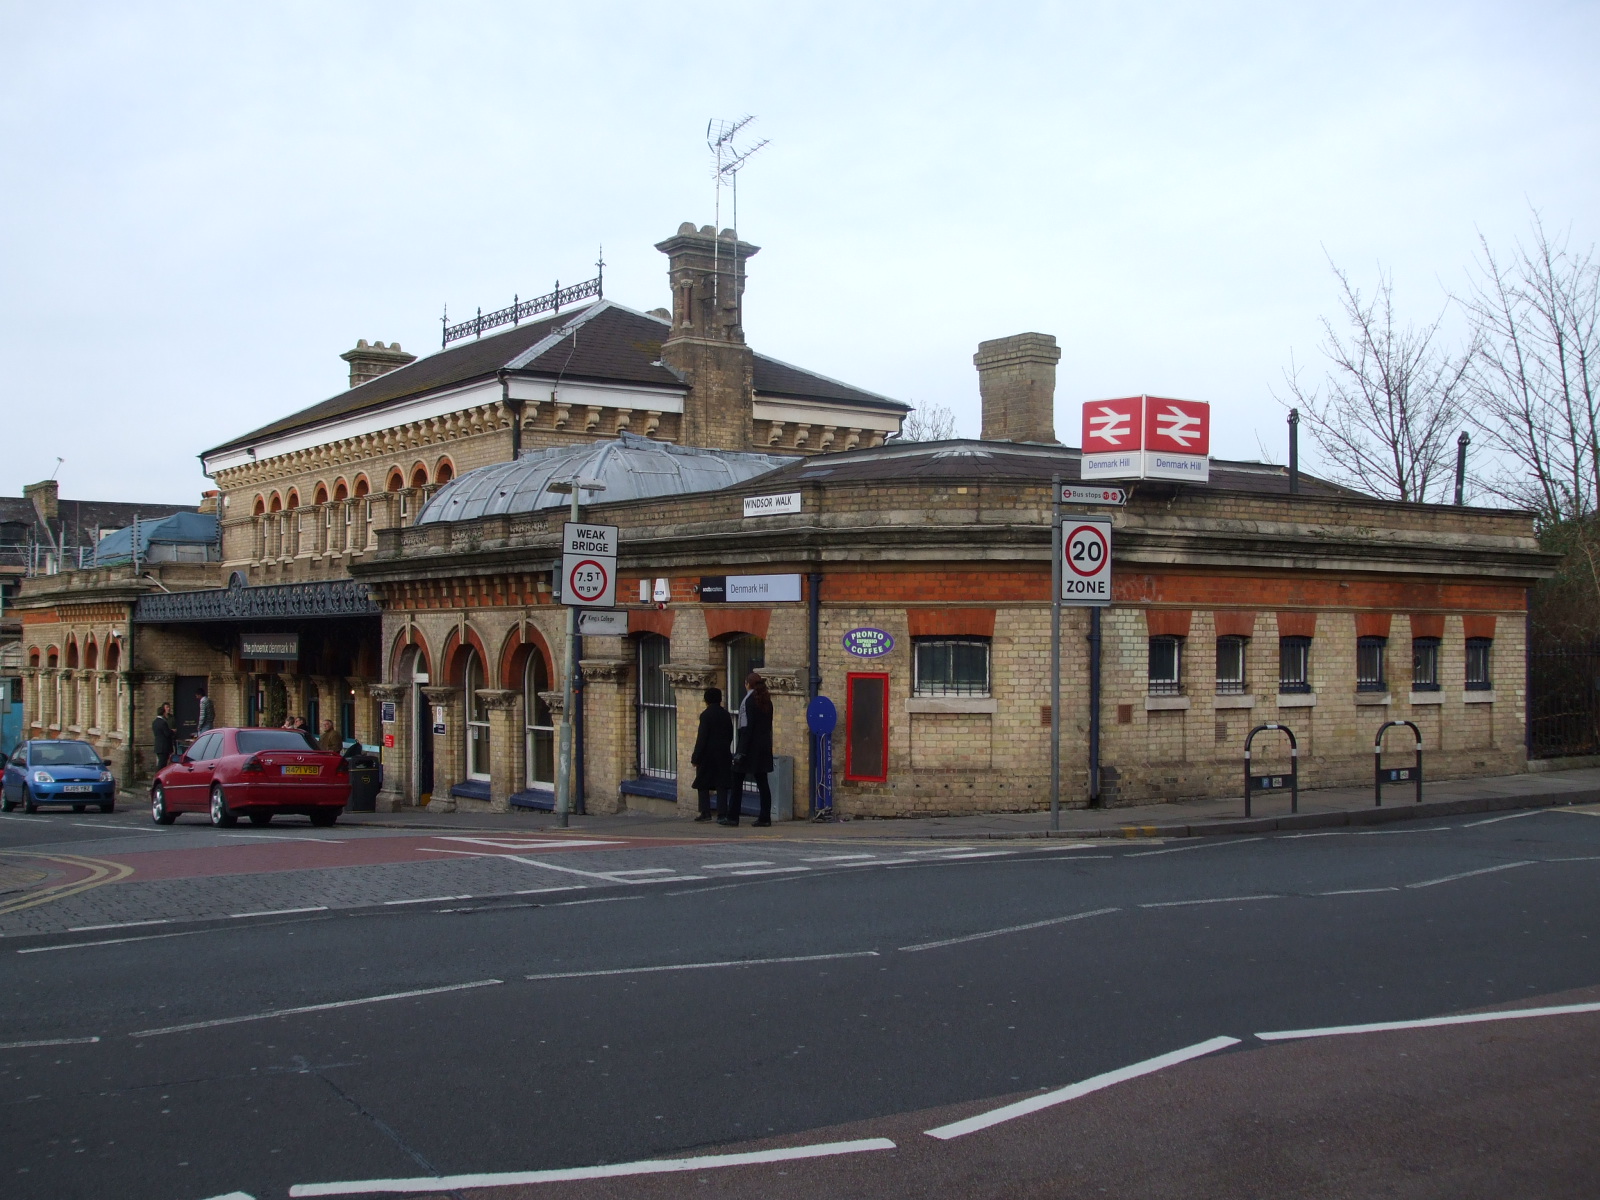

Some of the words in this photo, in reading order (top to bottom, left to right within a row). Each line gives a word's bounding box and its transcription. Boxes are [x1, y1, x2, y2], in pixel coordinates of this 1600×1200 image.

[1089, 459, 1118, 469] Denmark
[1119, 458, 1131, 467] Hill
[1156, 458, 1188, 470] Denmark
[1190, 461, 1202, 471] Hill
[1072, 490, 1084, 498] Bus
[1085, 491, 1102, 500] stops
[744, 497, 773, 509] WINDSOR
[775, 495, 792, 507] WALK
[576, 528, 606, 540] WEAK
[571, 540, 609, 552] BRIDGE
[1072, 540, 1102, 562] 20
[730, 584, 758, 594] Denmark
[759, 583, 769, 593] Hill
[1066, 580, 1106, 594] ZONE
[851, 630, 884, 640] PRONTO
[243, 641, 251, 653] the
[250, 641, 269, 656] phoenix
[268, 641, 289, 654] denmark
[289, 641, 297, 654] hill
[851, 645, 884, 655] COFFEE
